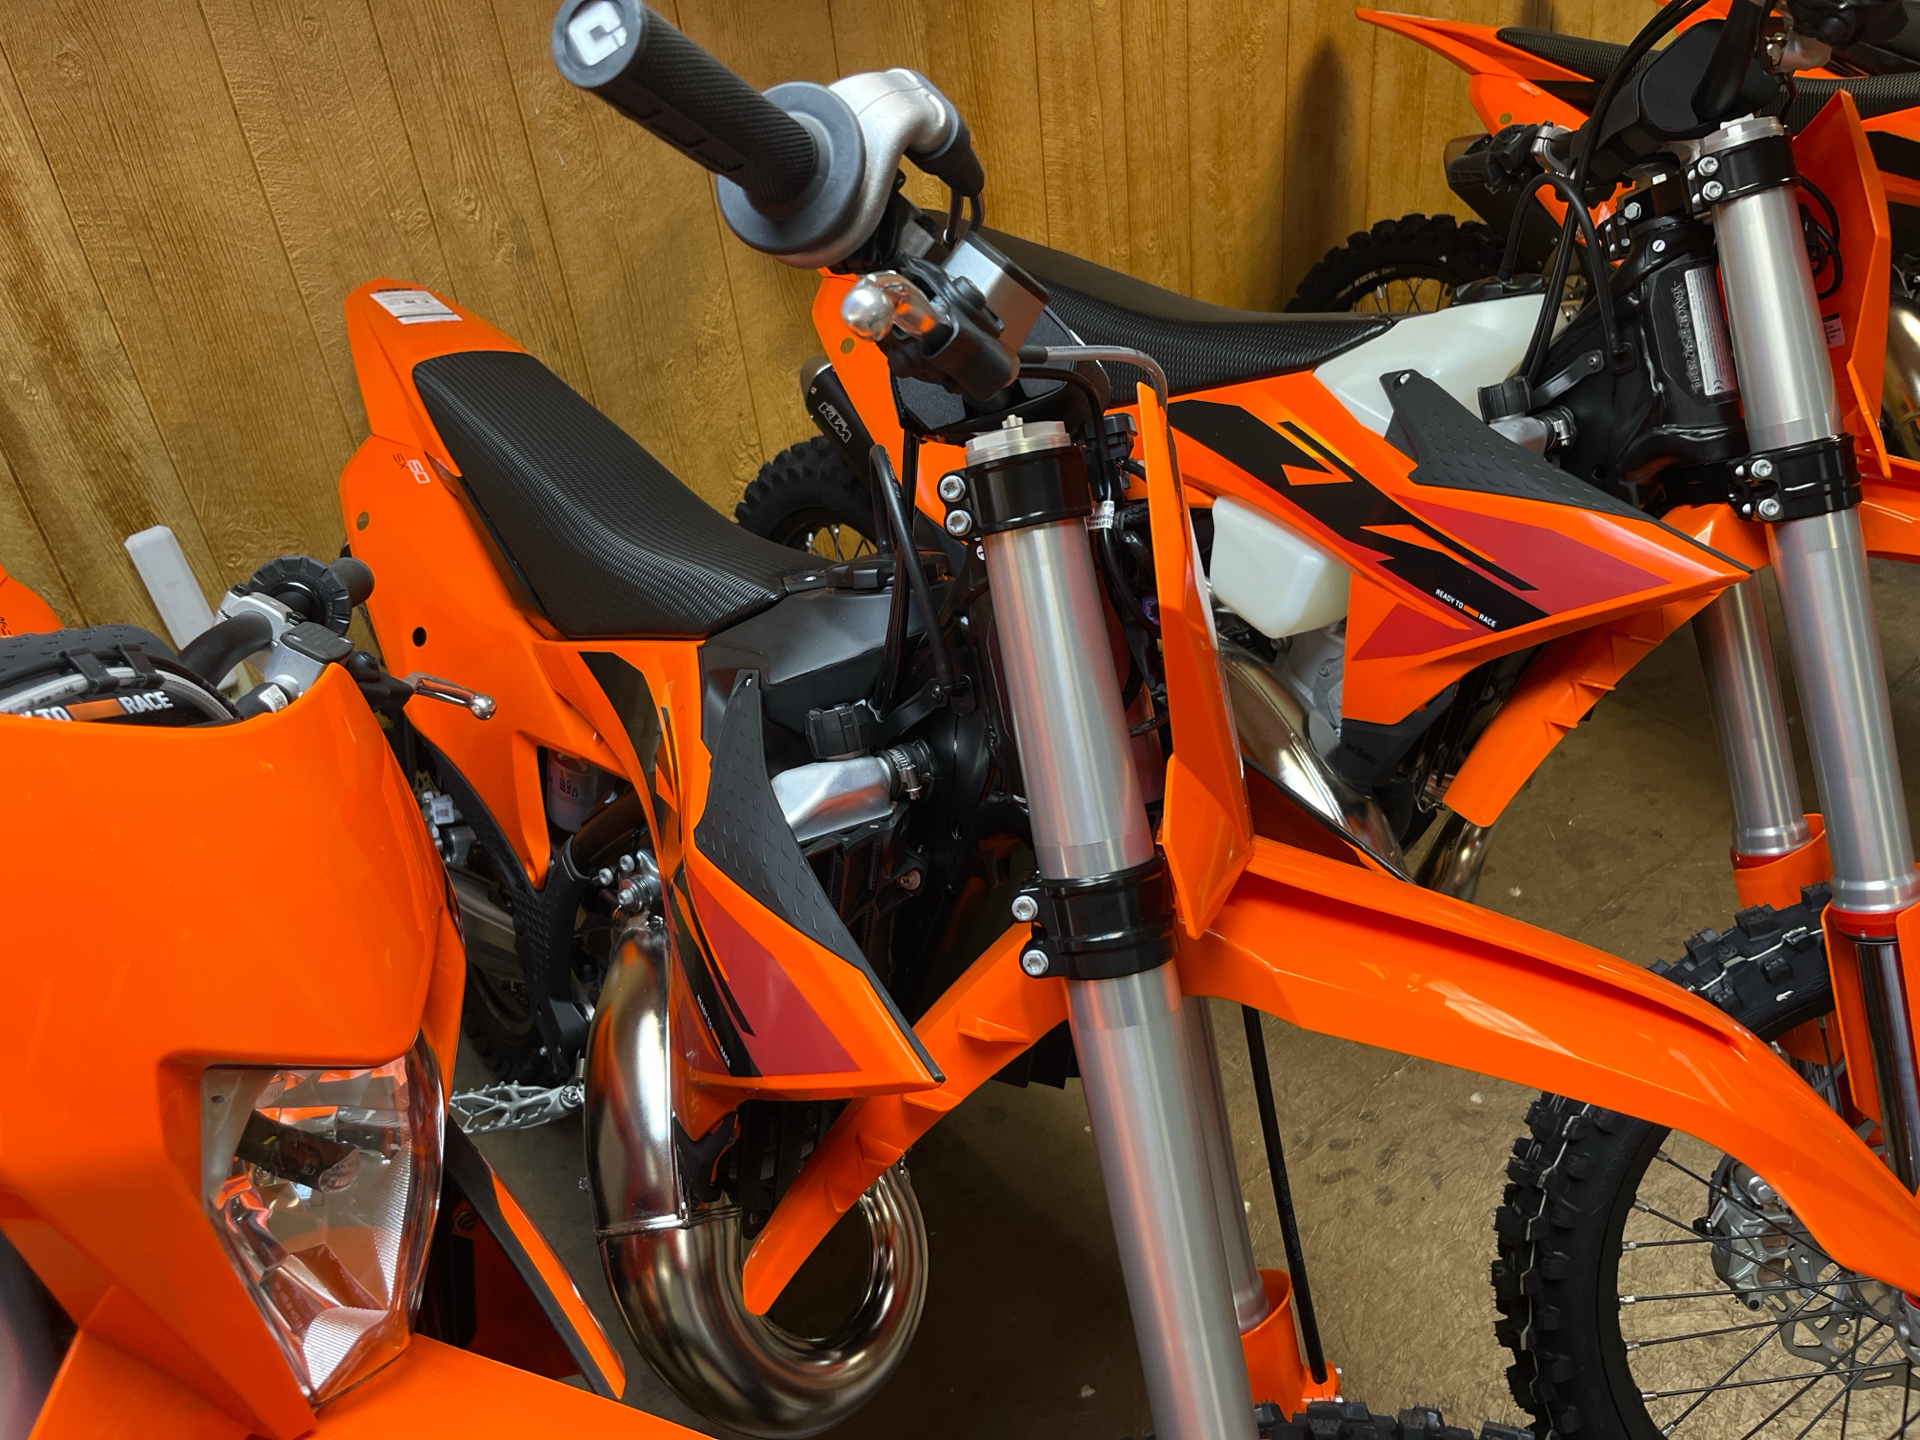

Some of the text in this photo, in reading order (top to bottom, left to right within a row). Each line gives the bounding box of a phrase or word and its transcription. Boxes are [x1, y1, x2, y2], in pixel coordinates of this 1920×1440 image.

[818, 401, 852, 443] KTM
[393, 453, 409, 470] SX
[1435, 588, 1497, 628] READY TO RACE
[118, 690, 175, 714] RACE
[720, 1044, 731, 1068] RACE
